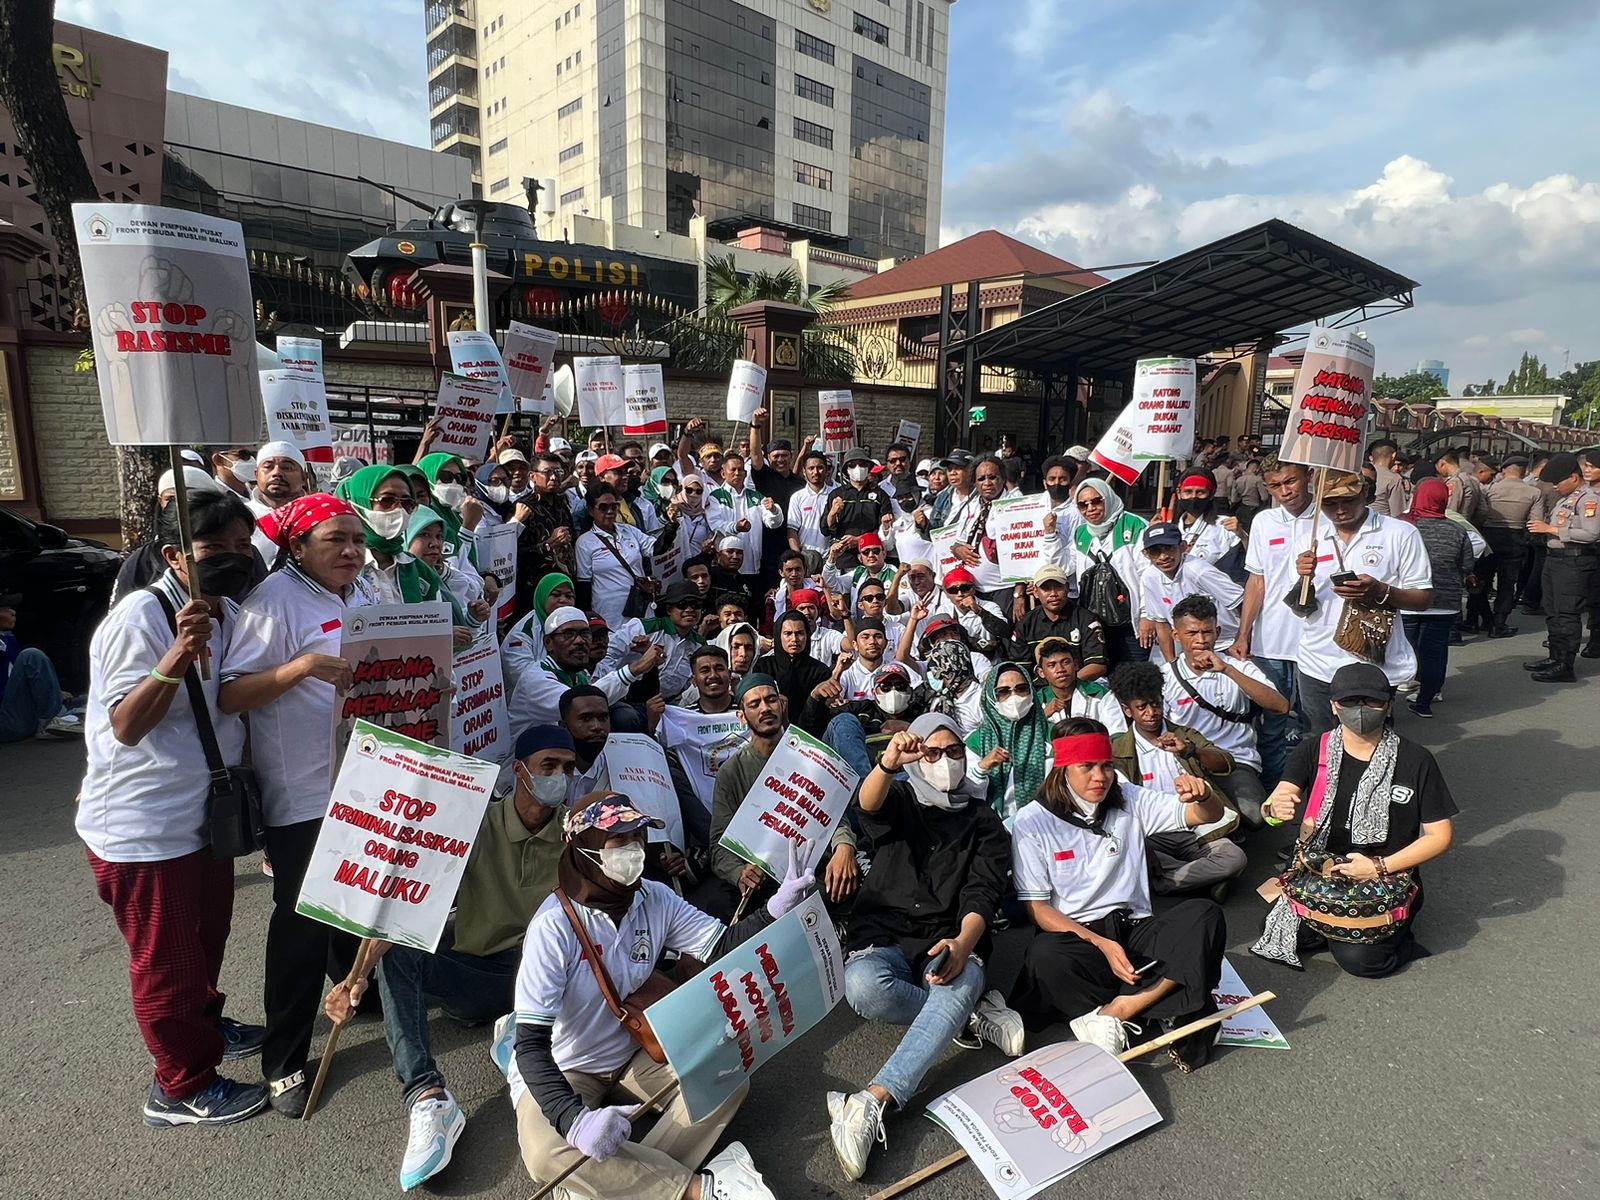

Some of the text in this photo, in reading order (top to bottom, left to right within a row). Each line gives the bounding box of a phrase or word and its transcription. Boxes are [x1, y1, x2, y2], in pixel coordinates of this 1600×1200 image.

[116, 226, 239, 247] FRONT PEMUDA MUSLIM MALUKU
[130, 219, 223, 238] DEWAN PIMPINAN PUSAT
[524, 253, 638, 286] POLISI
[130, 301, 207, 326] STOP
[115, 330, 232, 355] RASISME
[1152, 388, 1181, 398] KATONG
[1313, 369, 1365, 394] KATONG
[437, 406, 493, 423] DISKRIMINASI
[457, 396, 480, 407] STOP
[1138, 400, 1191, 410] ORANG MALUKU
[1300, 394, 1367, 418] MENOLAK
[447, 421, 477, 433] ORANG
[1147, 424, 1183, 434] PENJAHAT
[1153, 412, 1178, 421] BUKAN
[441, 433, 477, 446] MALUKU
[1297, 419, 1361, 444] RASISME
[1000, 531, 1021, 541] ORANG
[1010, 520, 1033, 529] KATONG
[1010, 551, 1040, 560] PENJAHAT
[354, 656, 435, 684] KATONG
[461, 669, 484, 692] STOP
[342, 688, 441, 718] MENOLAK
[455, 682, 503, 717] SKRIMINASI
[463, 708, 493, 736] ORANG
[697, 725, 711, 735] FRONT
[712, 724, 729, 733] PEMUDA
[463, 727, 497, 756] MALUKU
[379, 755, 486, 793] FRONT PEMUDA MUSLIM MALUKU
[394, 753, 475, 782] DEWAN PIMPINAN PUSAT
[788, 772, 826, 801] KATONG
[379, 789, 437, 822] STOP
[764, 776, 832, 828] ORANG MALUKU
[774, 801, 809, 829] BUKAN
[329, 802, 470, 858] KRIMINALISASIKAN
[758, 811, 807, 847] PENJAHAT
[364, 840, 419, 868] ORANG
[333, 860, 431, 904] MALUKU
[754, 943, 795, 1038] MELANESIA
[739, 971, 774, 1043] MOYANG
[709, 970, 755, 1073] NUSANTARA
[1010, 1085, 1058, 1130] STOP
[1017, 1066, 1090, 1135] RASISME
